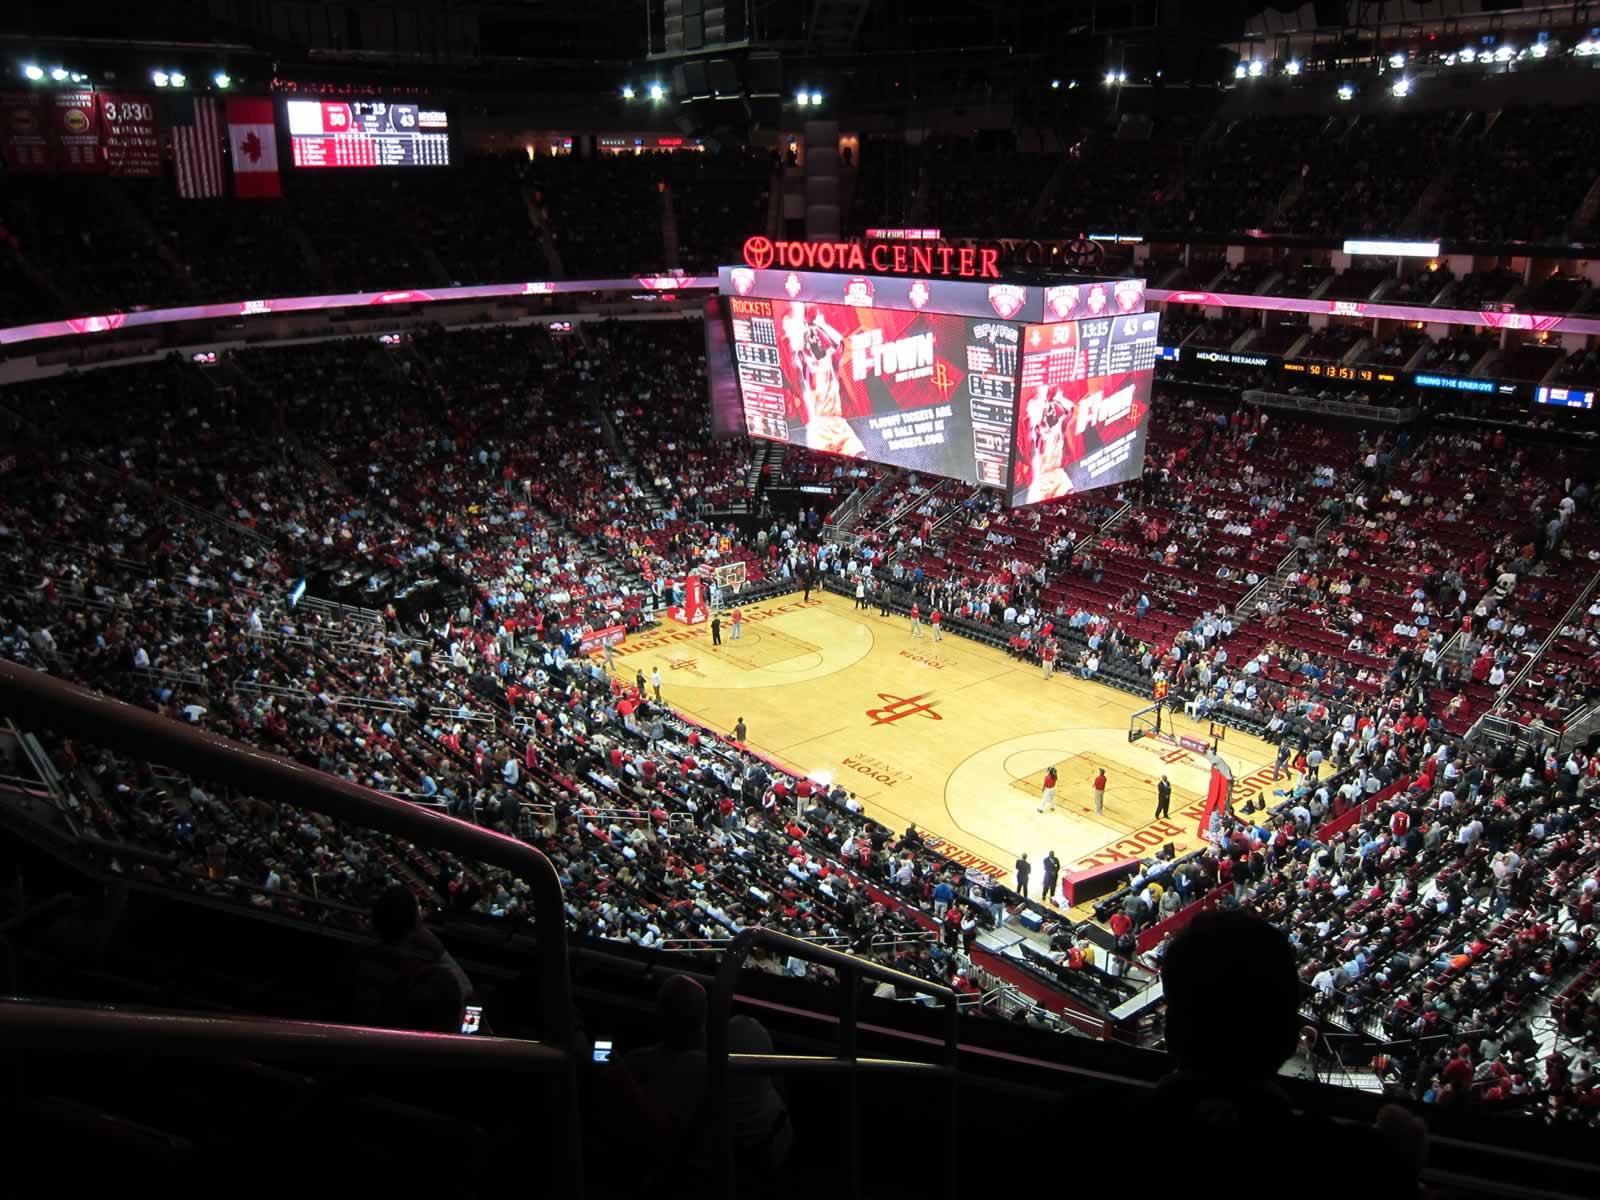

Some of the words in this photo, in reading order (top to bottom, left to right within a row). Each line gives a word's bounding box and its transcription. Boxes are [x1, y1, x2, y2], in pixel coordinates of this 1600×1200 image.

[775, 242, 867, 269] TOYOTA
[872, 244, 999, 278] CENTER
[732, 299, 772, 316] ROCKETS
[1051, 326, 1070, 345] 50
[1081, 321, 1109, 339] 13:15
[1196, 352, 1230, 362] MEMORIAL
[1231, 355, 1267, 366] HERMANN
[1310, 365, 1320, 375] 50
[1361, 371, 1372, 380] 43
[1416, 376, 1440, 386] BRING
[1441, 378, 1457, 388] THE
[841, 757, 897, 788] TOYOTA
